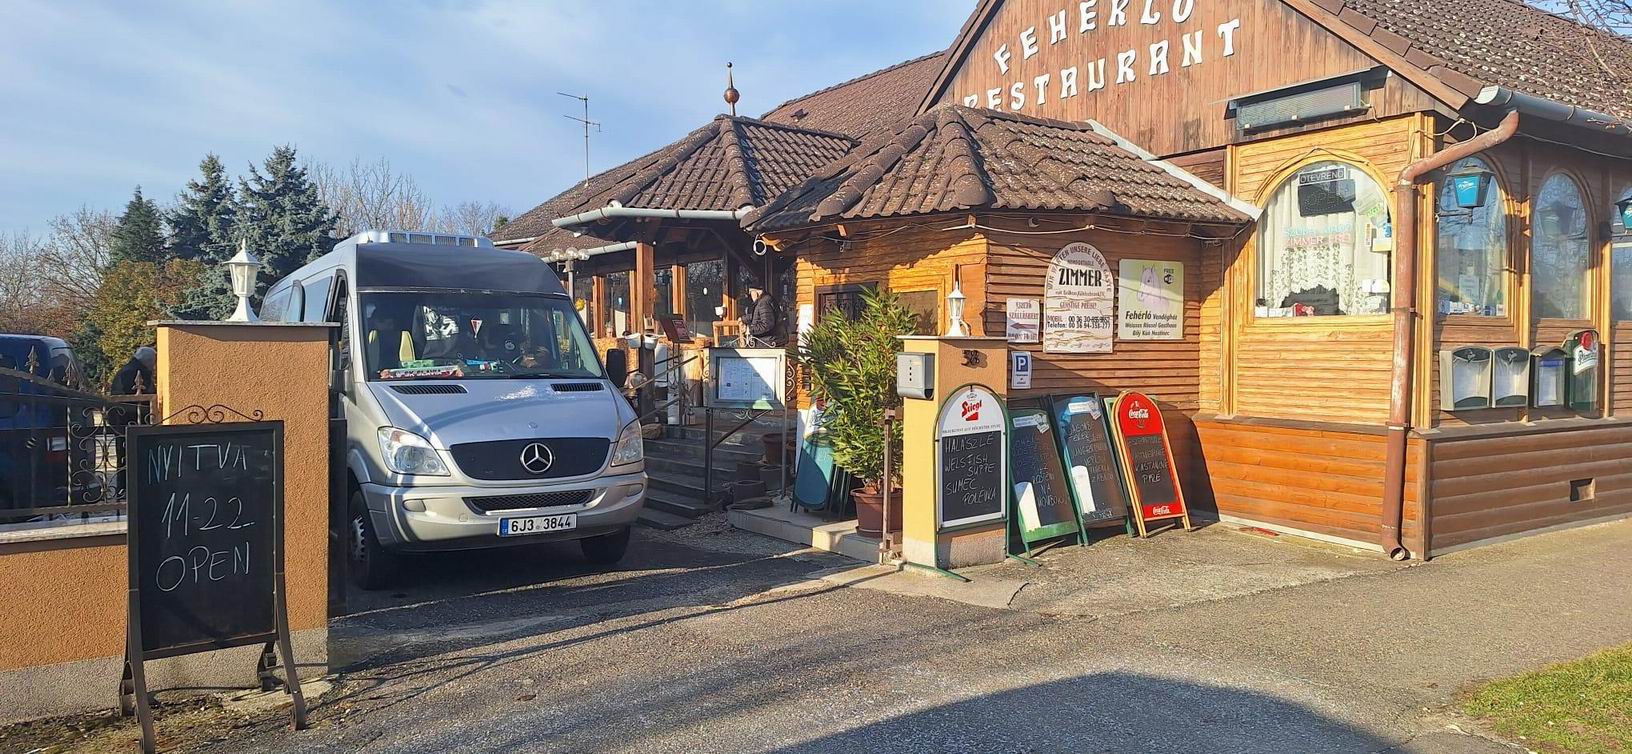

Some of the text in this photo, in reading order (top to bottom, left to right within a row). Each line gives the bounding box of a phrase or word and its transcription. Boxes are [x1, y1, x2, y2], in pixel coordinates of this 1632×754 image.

[1069, 245, 1092, 256] UNSERE
[1058, 268, 1102, 287] ZIMMER
[1125, 310, 1152, 320] Fehérló
[1017, 357, 1027, 371] P
[961, 399, 983, 418] Stiegl
[148, 441, 250, 485] NYITVA
[161, 492, 256, 539] 11-22
[511, 516, 571, 532] 6J3 3844
[156, 542, 251, 592] OPEN
